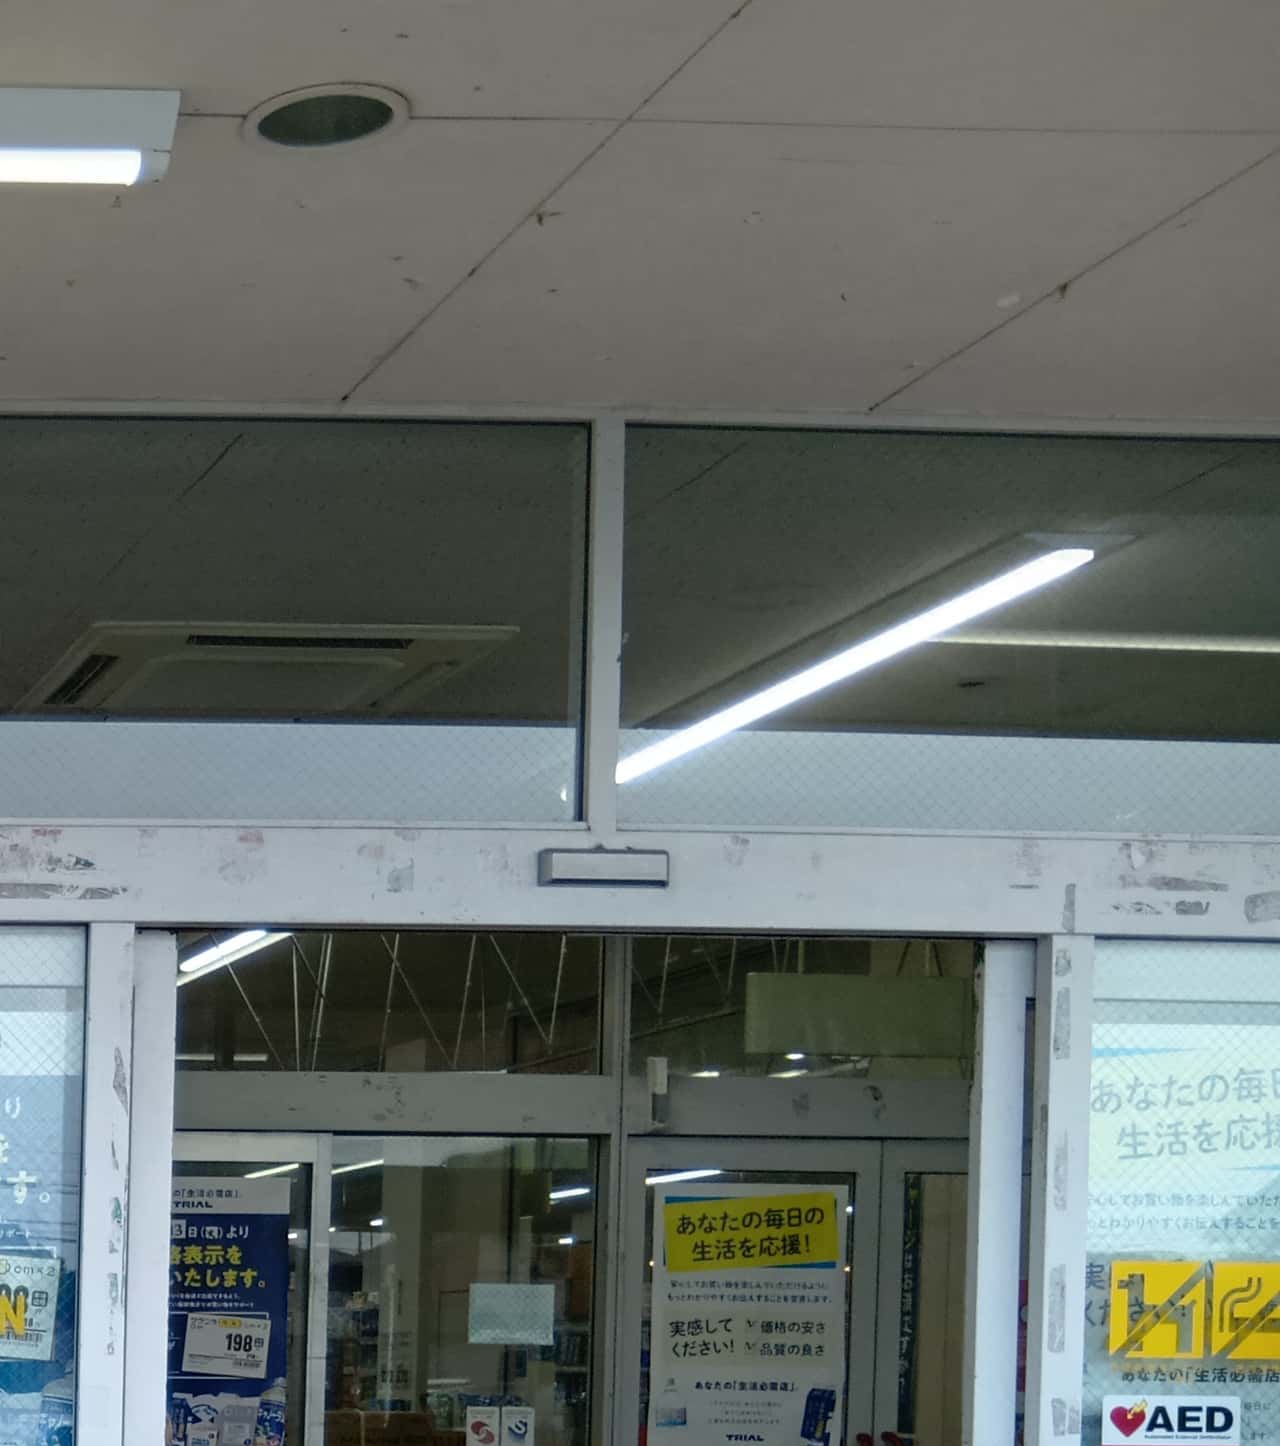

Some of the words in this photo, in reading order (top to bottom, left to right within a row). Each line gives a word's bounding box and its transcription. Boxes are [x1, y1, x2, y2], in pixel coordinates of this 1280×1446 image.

[676, 1207, 825, 1236] あなたの毎日の
[692, 1233, 811, 1262] 生活を応援!
[669, 1318, 734, 1338] 実感して
[760, 1320, 826, 1335] 価格の安さ
[671, 1339, 735, 1358] ください!
[760, 1343, 826, 1357] 品質の良さ
[1145, 1406, 1234, 1433] AED
[725, 1434, 765, 1442] TRIAL
